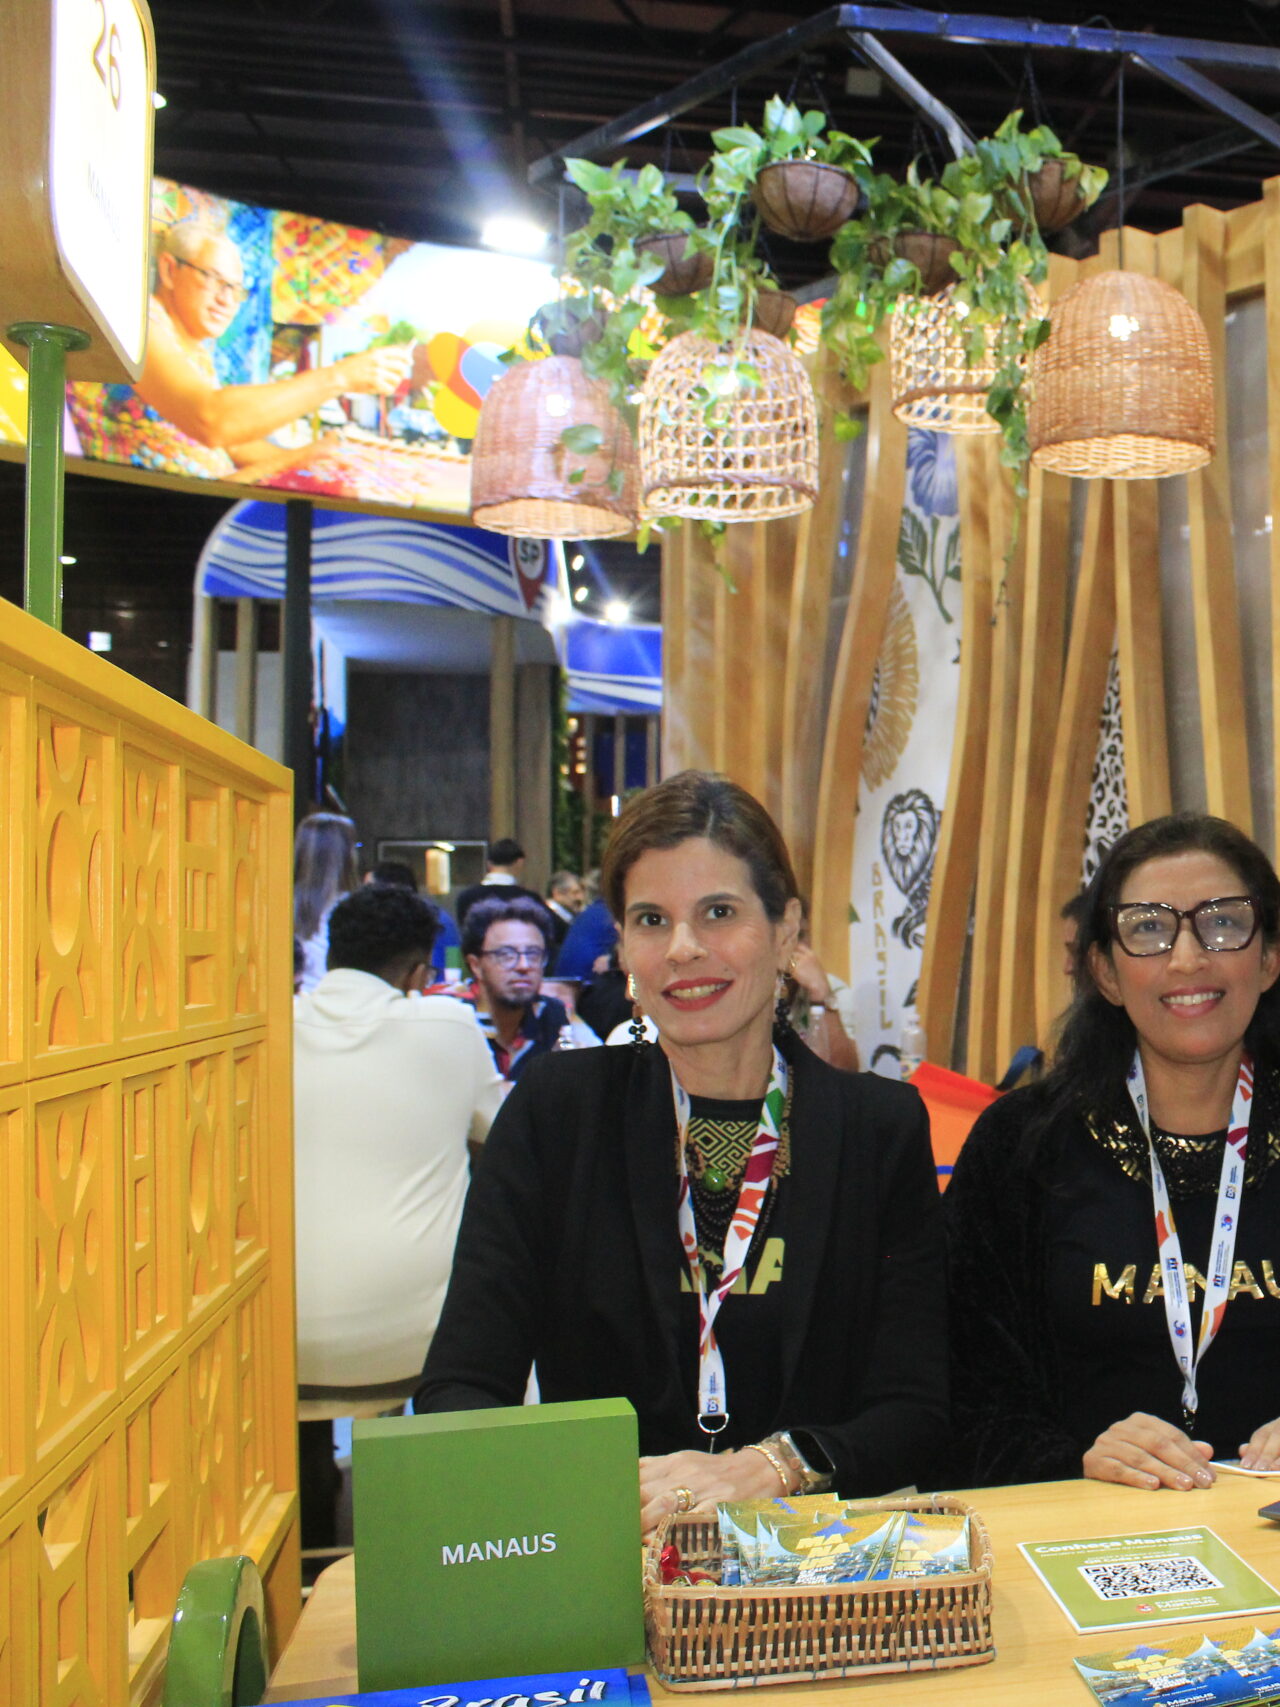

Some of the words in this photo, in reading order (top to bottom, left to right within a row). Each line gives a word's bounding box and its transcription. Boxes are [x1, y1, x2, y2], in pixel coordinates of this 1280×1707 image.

[442, 1532, 557, 1566] MANAUS
[1034, 1539, 1122, 1555] Conheça
[1124, 1533, 1203, 1546] Manaus
